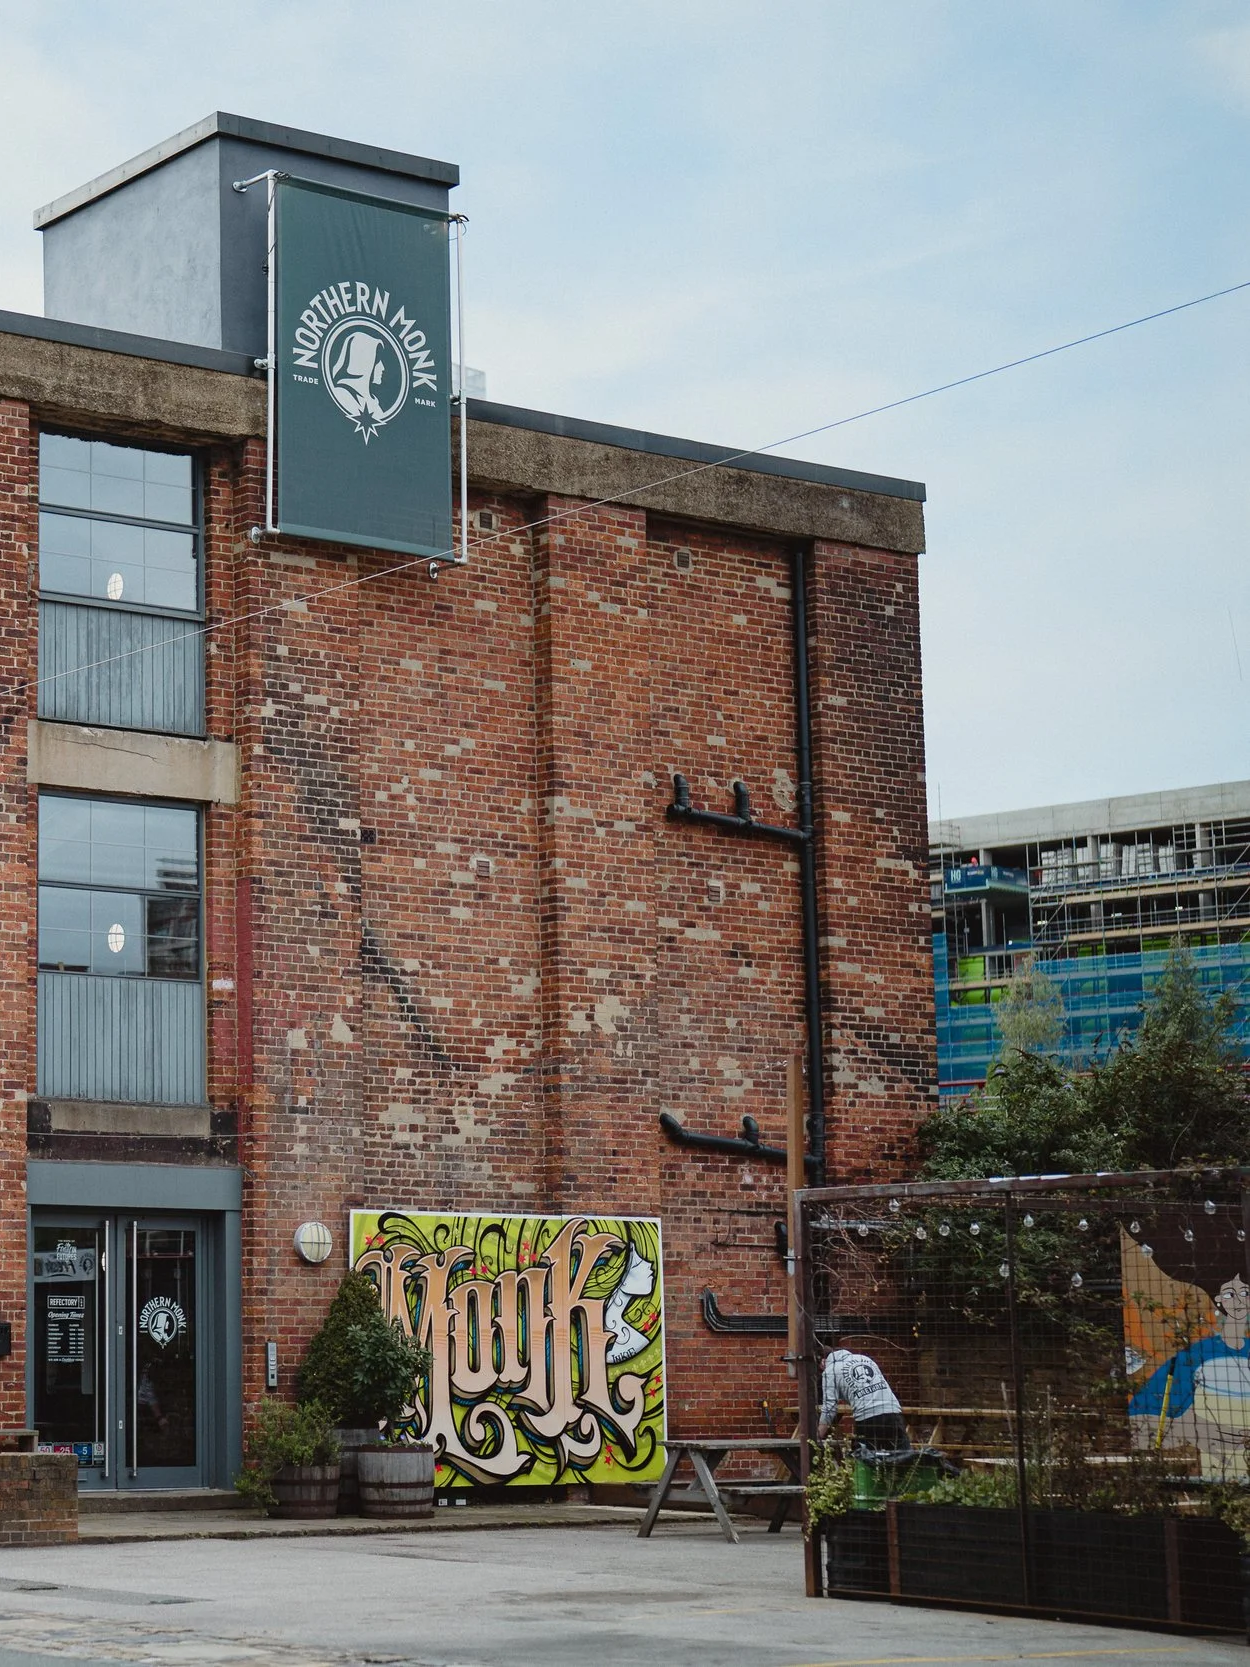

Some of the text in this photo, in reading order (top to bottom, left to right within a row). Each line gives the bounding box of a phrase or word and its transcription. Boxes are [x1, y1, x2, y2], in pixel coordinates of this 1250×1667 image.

[293, 281, 438, 392] NORTHERN MONK
[293, 374, 319, 385] TRADE
[414, 397, 436, 408] MARK
[49, 1298, 78, 1306] REFECTORY
[48, 1311, 85, 1319] Opening Times
[139, 1296, 187, 1328] NORTHERN MONK
[82, 1446, 88, 1455] 5
